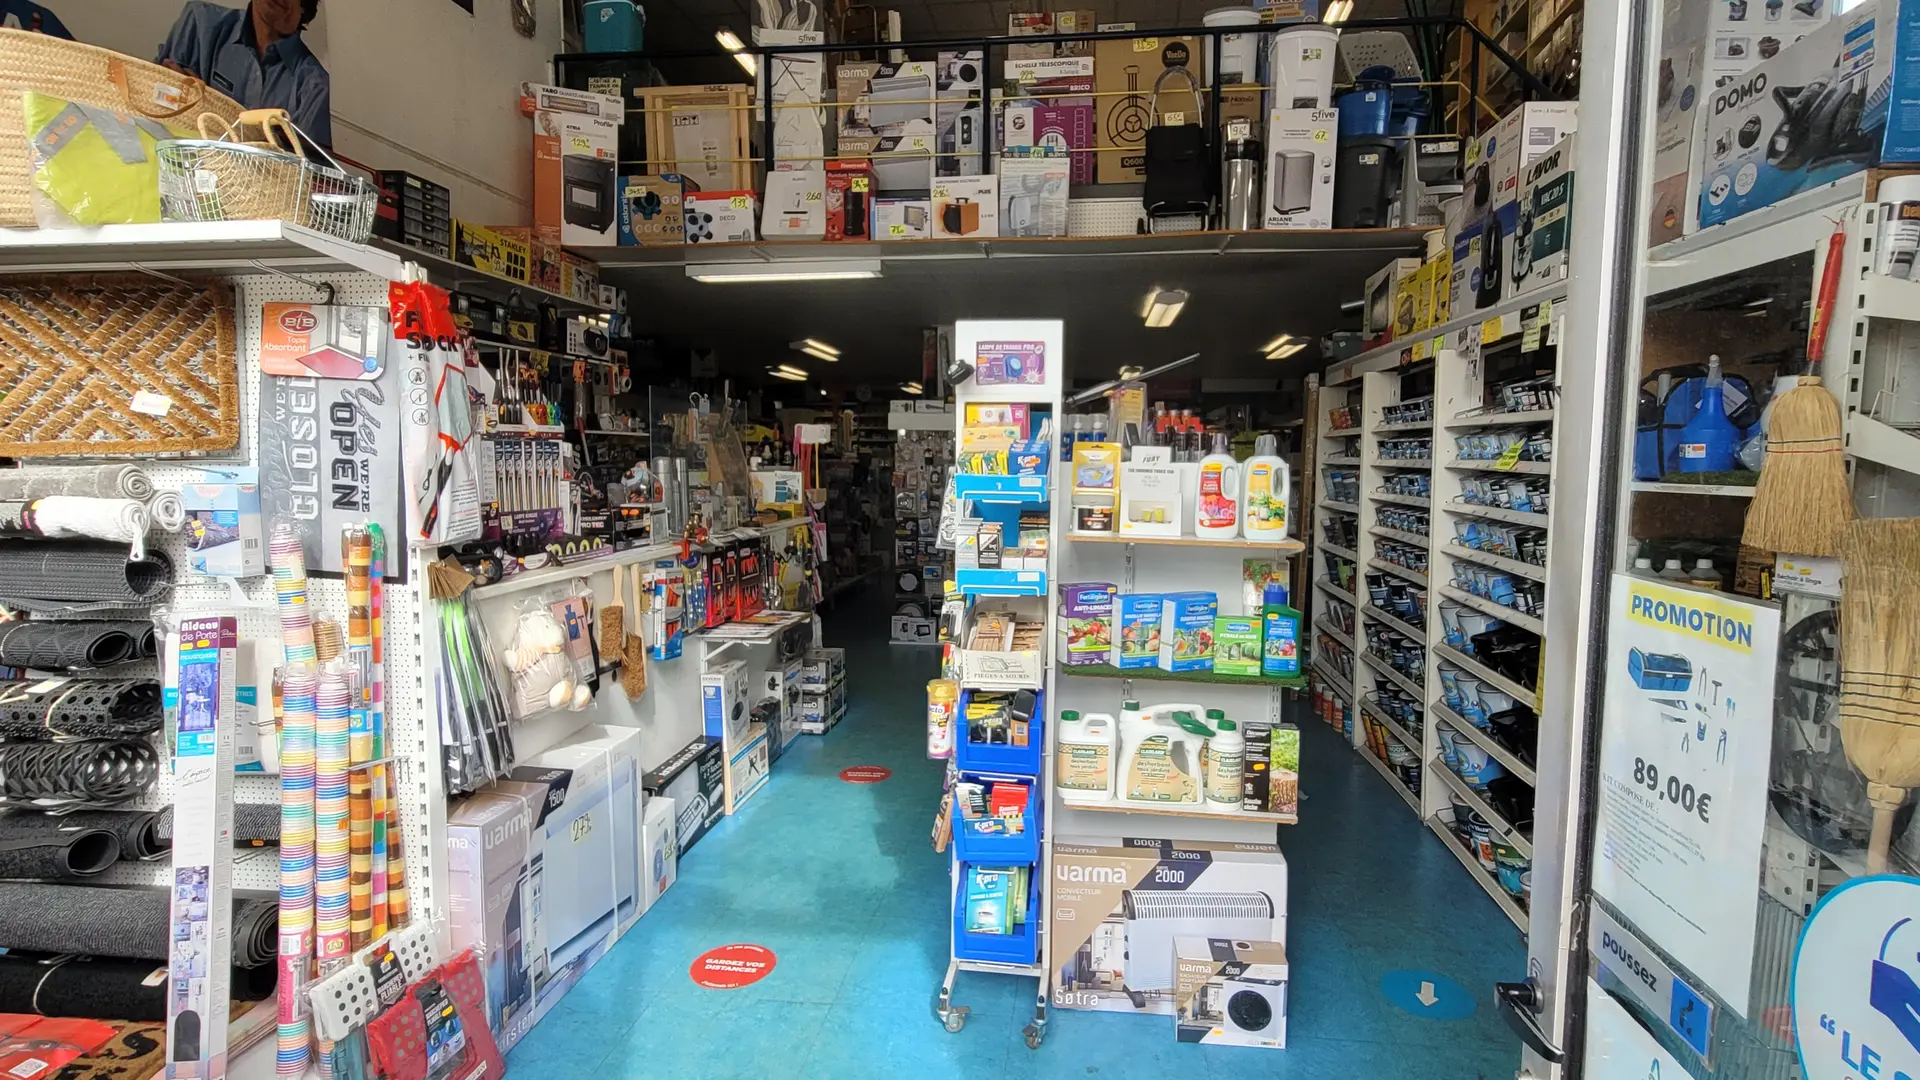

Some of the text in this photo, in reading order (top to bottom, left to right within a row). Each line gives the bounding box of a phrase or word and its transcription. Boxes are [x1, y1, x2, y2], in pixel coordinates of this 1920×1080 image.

[1715, 73, 1767, 115] DOMO
[1311, 110, 1336, 122] 5five
[1526, 150, 1561, 186] LAVOR
[500, 239, 526, 254] STANLEY
[263, 343, 306, 352] Absorbant
[329, 402, 360, 512] OPEN
[1142, 455, 1161, 464] FURY
[359, 457, 371, 513] WE'RE
[1631, 594, 1752, 648] PROMOTION
[181, 632, 194, 641] de
[196, 631, 218, 640] Porte
[1633, 757, 1712, 823] 89,00€
[1155, 869, 1185, 883] 2000
[1057, 887, 1102, 895] CONVECTEUR
[704, 964, 757, 973] DISTANCES
[705, 958, 745, 967] GARDEZ
[1602, 928, 1657, 993] poussez
[1225, 967, 1240, 975] 2000
[380, 980, 405, 1002] PLIABLE
[1056, 989, 1098, 1006] Søtra
[1841, 1029, 1882, 1080] LE
